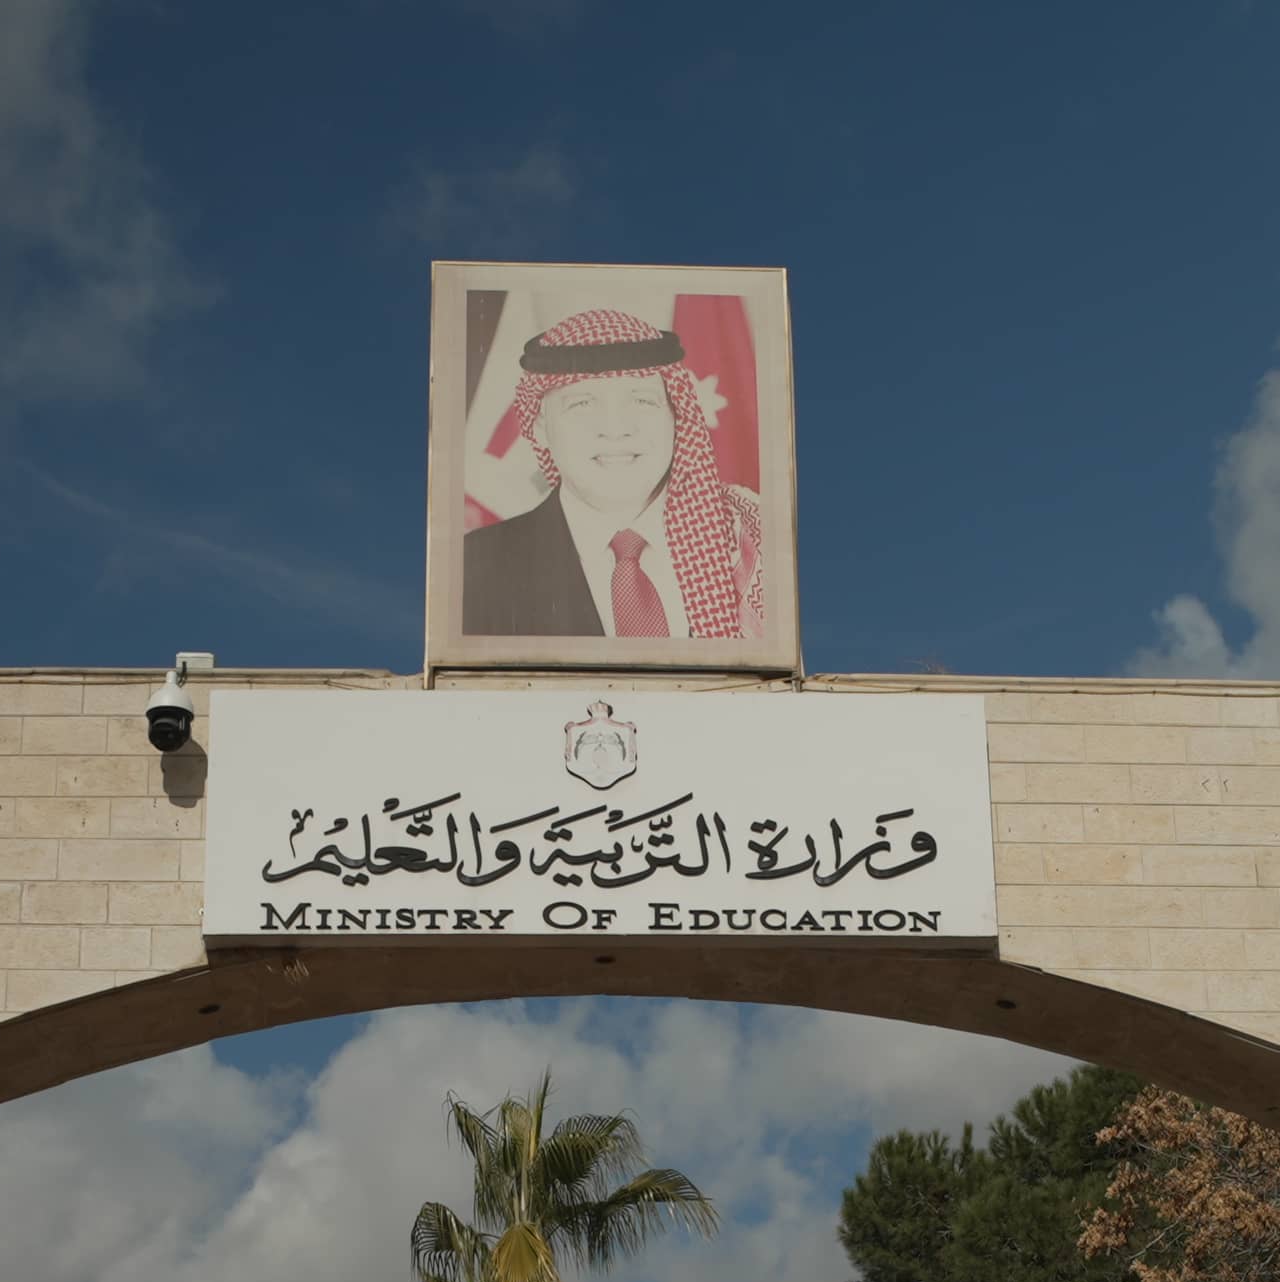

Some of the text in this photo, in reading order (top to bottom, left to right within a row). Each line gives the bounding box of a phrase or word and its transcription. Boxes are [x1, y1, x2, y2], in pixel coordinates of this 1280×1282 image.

[260, 901, 942, 932] MINISTRY OF EDUCATION
